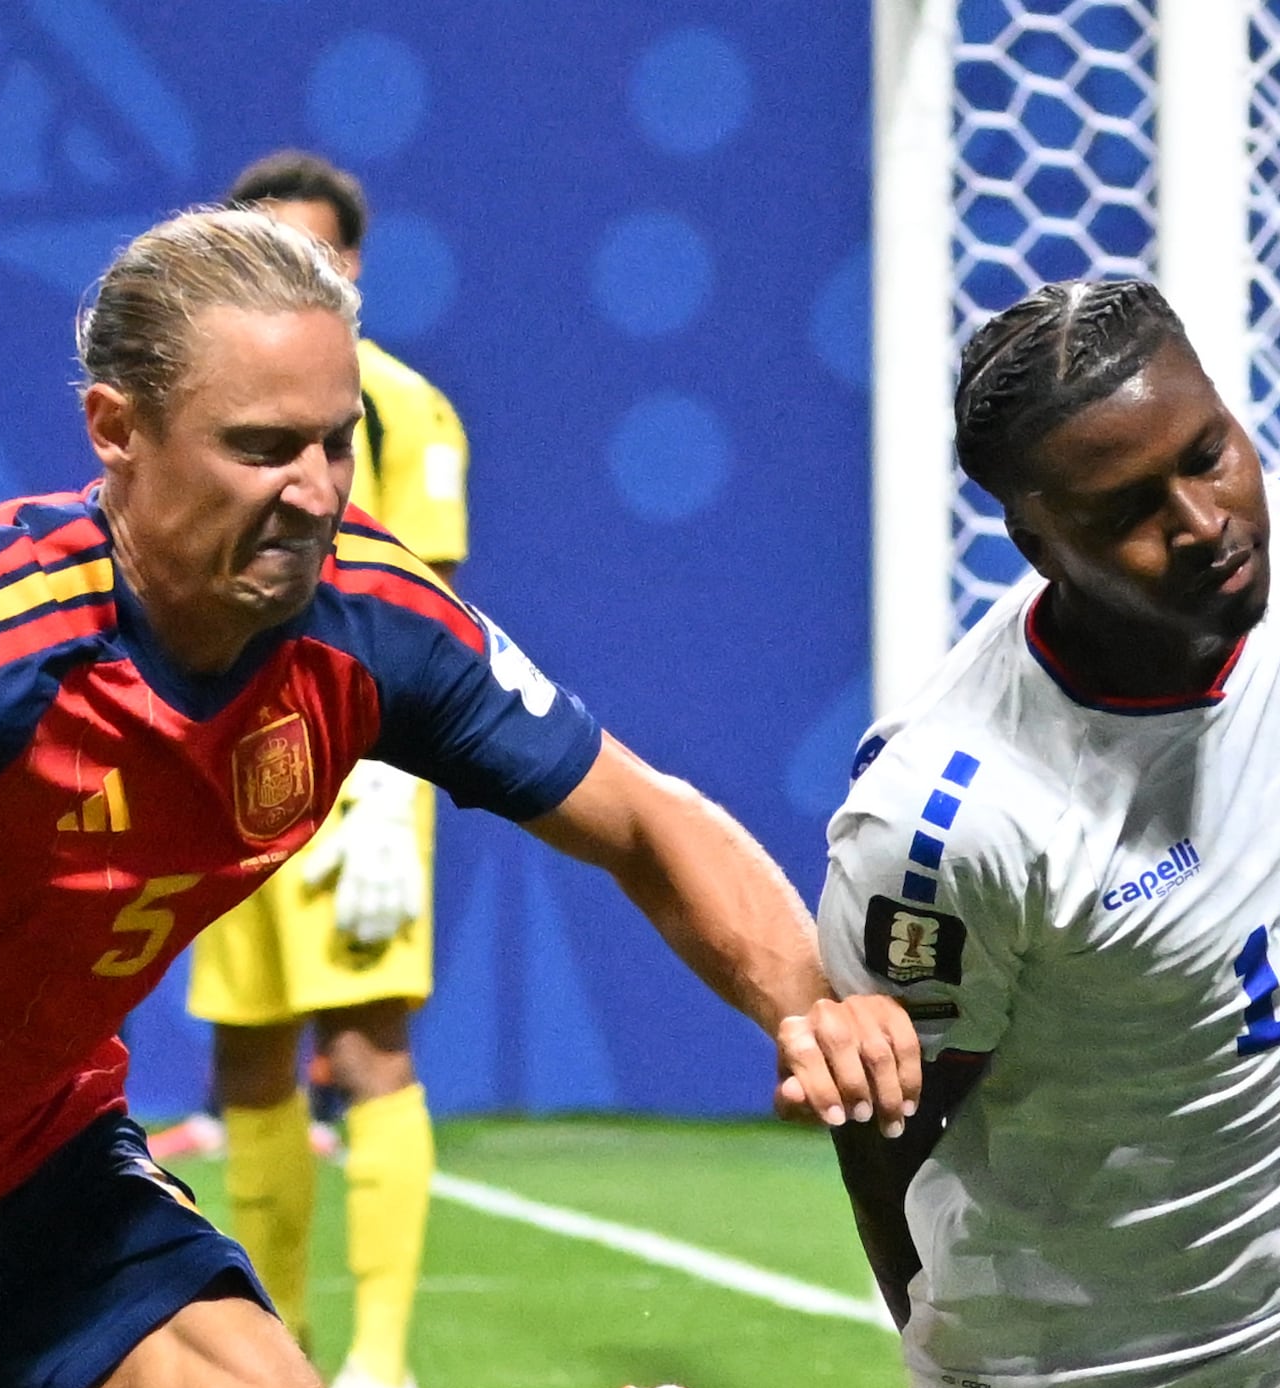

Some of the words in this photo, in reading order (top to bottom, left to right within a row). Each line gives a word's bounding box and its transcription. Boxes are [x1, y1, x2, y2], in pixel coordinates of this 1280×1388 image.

[1102, 837, 1200, 911] capelli
[1156, 864, 1201, 898] SPORT
[91, 873, 206, 977] 5
